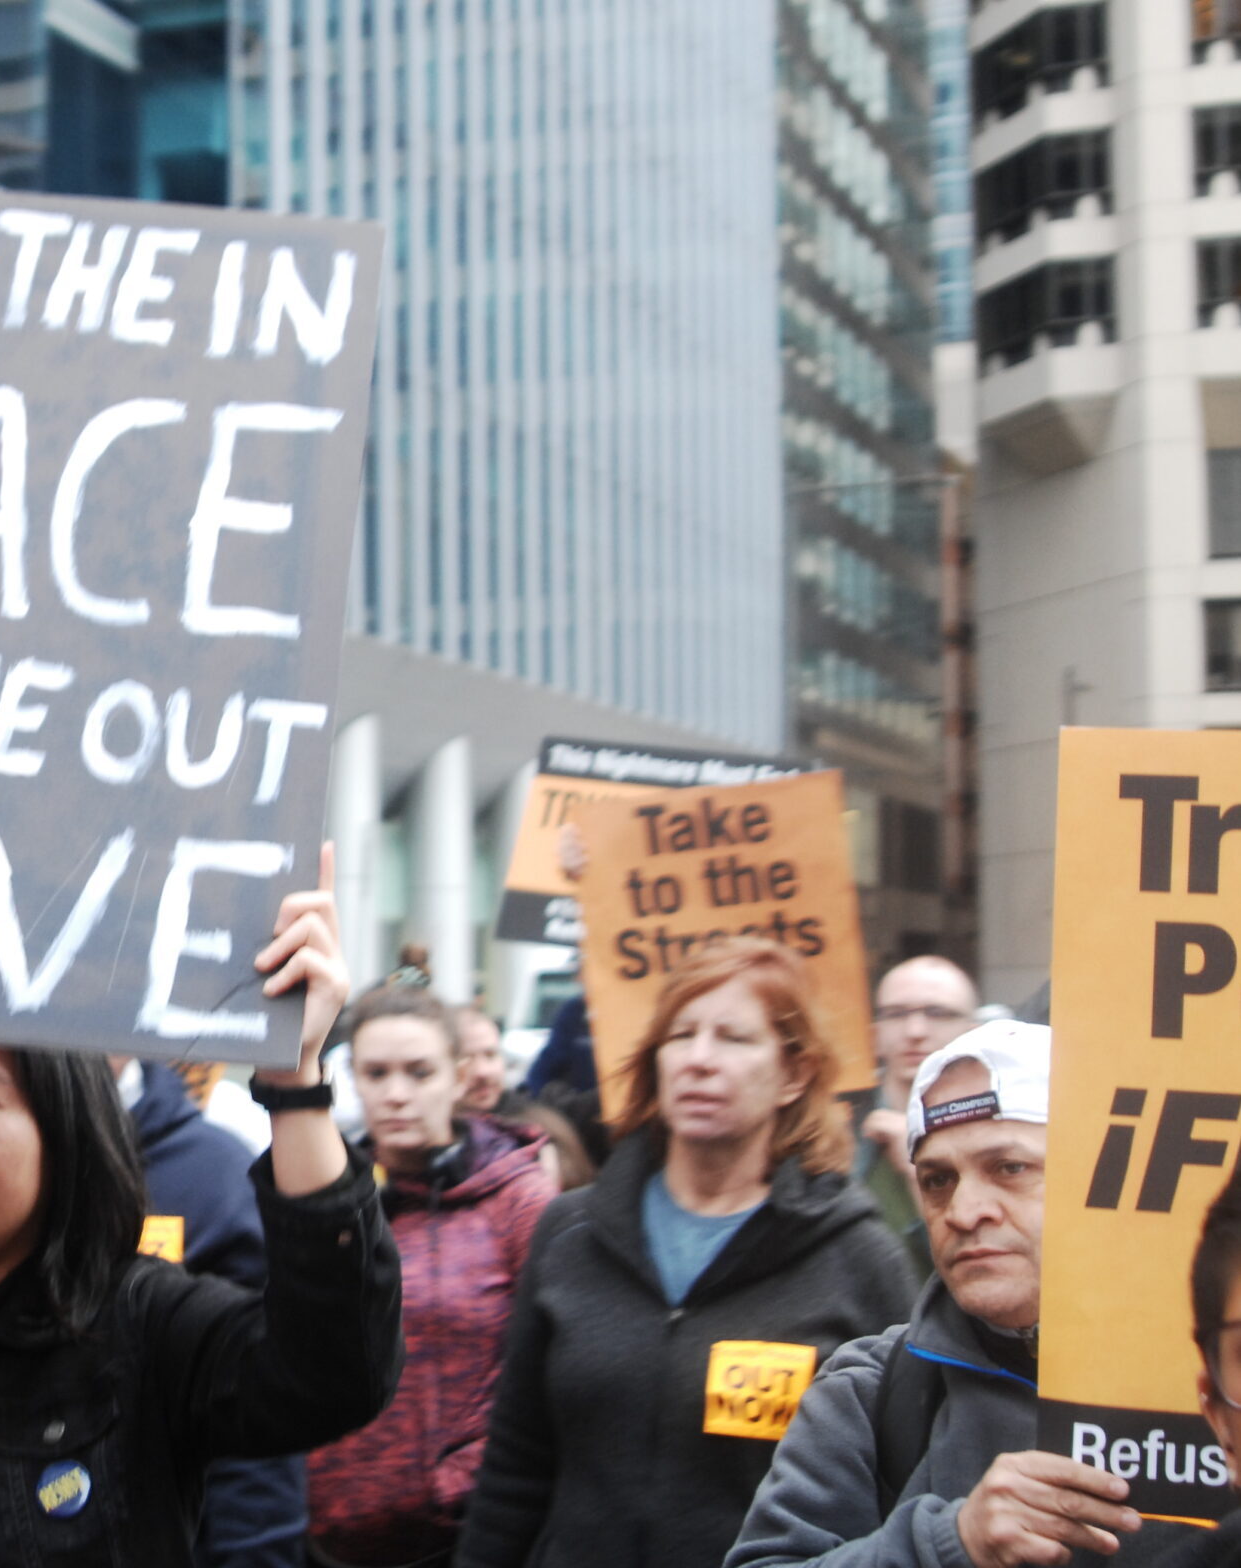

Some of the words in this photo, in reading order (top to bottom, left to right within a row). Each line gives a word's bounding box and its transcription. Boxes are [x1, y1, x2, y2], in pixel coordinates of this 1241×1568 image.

[205, 240, 356, 366] IN
[80, 678, 328, 805] OUT
[635, 797, 770, 856] Take
[628, 867, 682, 918] to
[702, 856, 798, 907] the
[725, 1364, 795, 1396] OUT
[1071, 1421, 1229, 1488] Refus
